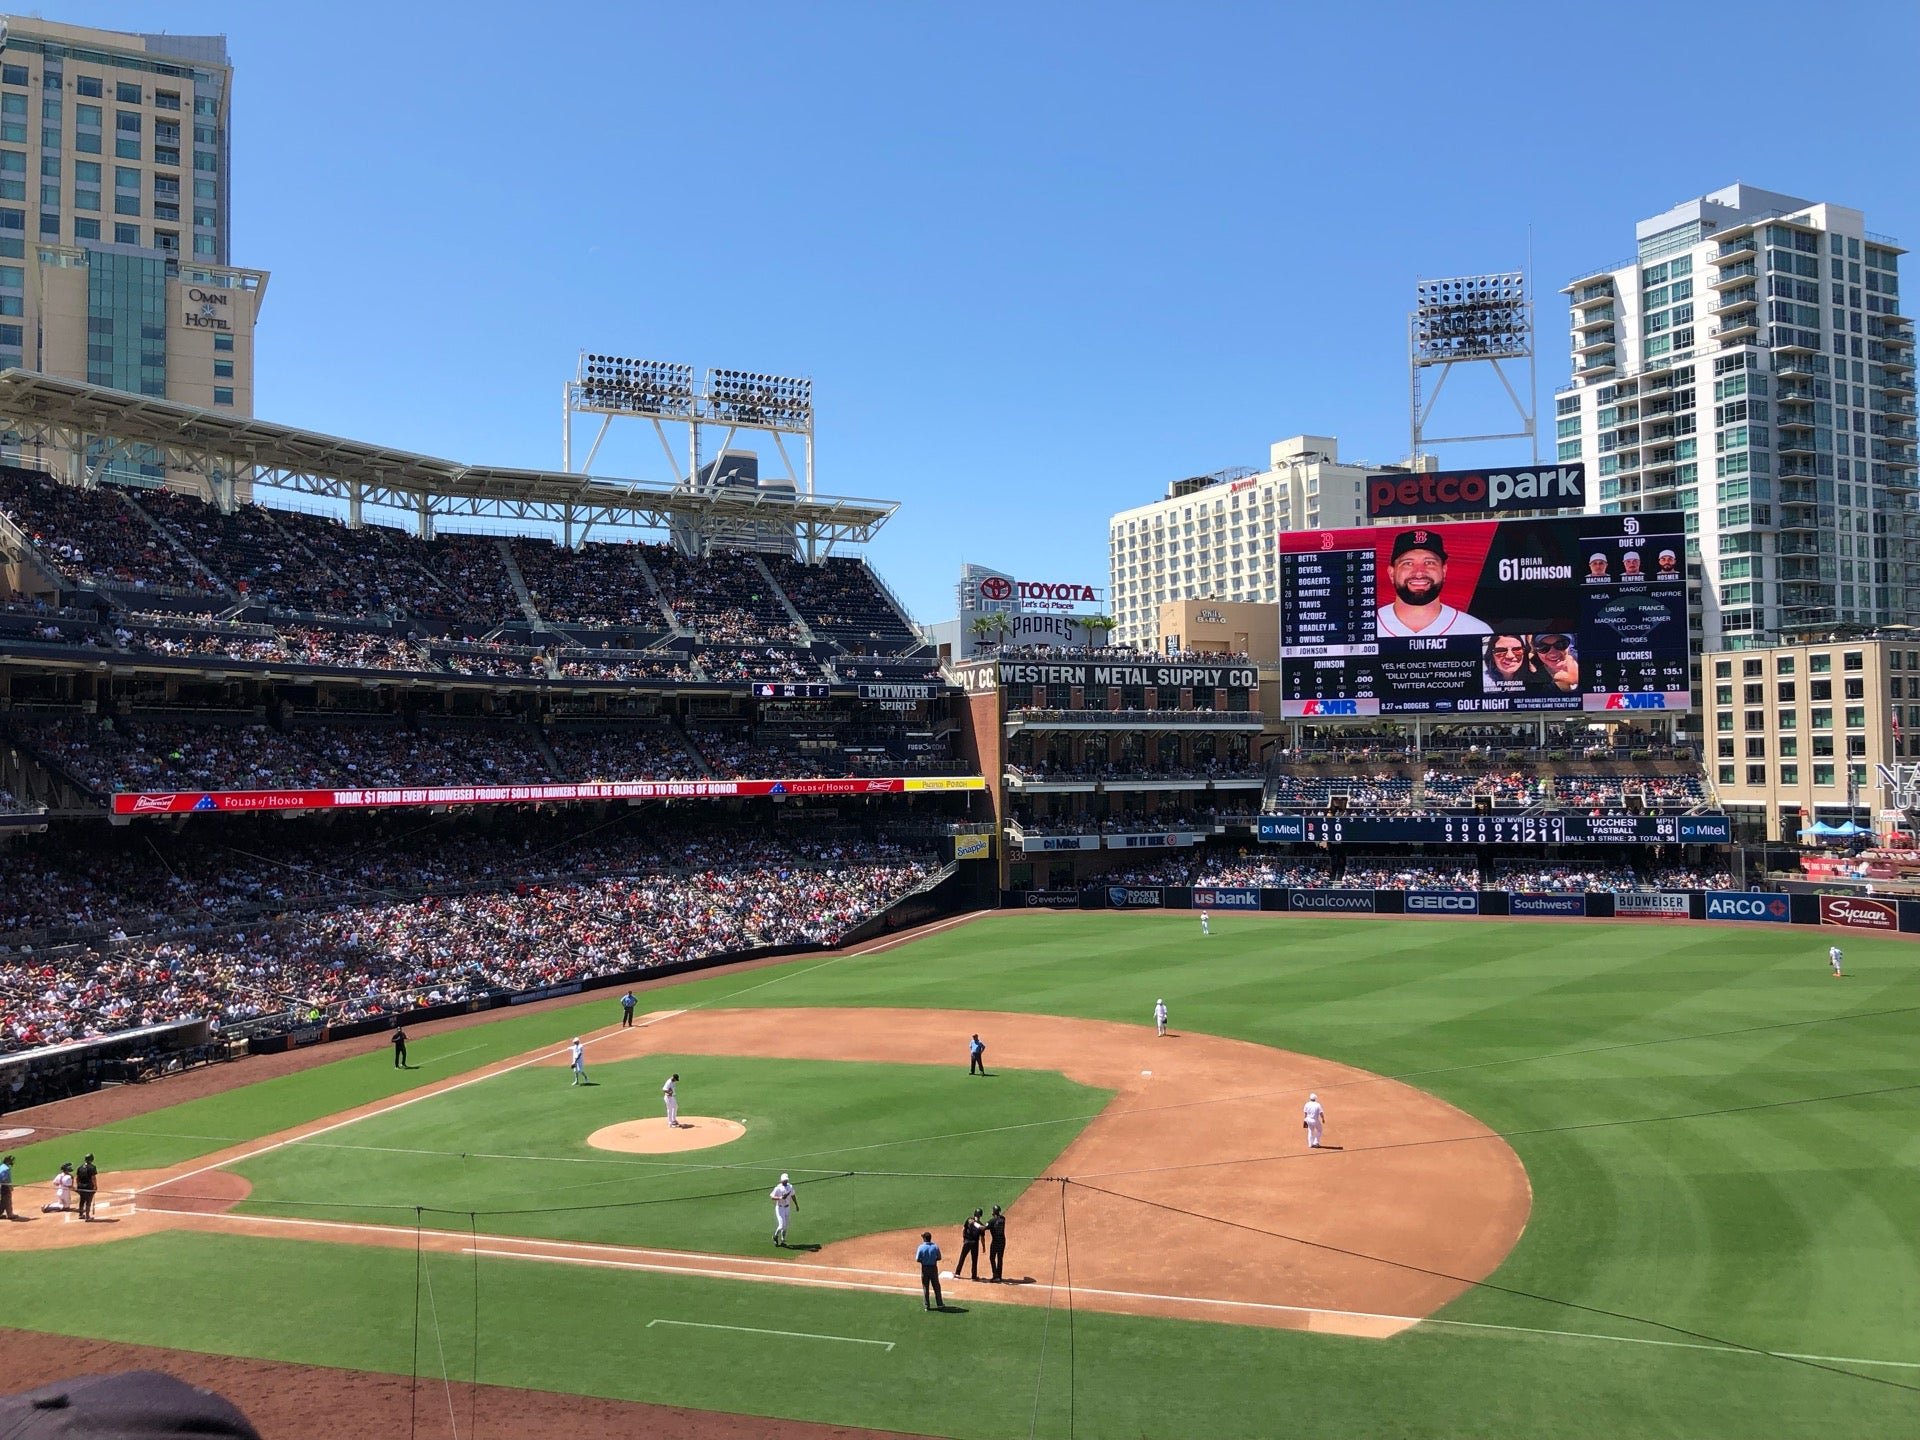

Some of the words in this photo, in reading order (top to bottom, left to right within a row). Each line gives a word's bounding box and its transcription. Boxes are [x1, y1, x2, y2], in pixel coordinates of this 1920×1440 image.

[189, 289, 227, 305] OMNI
[185, 313, 231, 329] HOTEL
[1372, 474, 1486, 513] petco
[1489, 468, 1581, 507] park
[1619, 539, 1633, 548] DUE
[1636, 538, 1646, 546] UP
[1360, 552, 1374, 560] .286
[1521, 557, 1542, 565] BRIAN
[1298, 566, 1322, 574] DEVERS
[1499, 559, 1519, 581] 61
[1521, 566, 1572, 580] JOHNSON
[1298, 577, 1330, 585] BOGAERTS
[1360, 575, 1375, 583] .307
[1017, 582, 1096, 601] TOYOTA
[1299, 589, 1330, 597] MARTINEZ
[1361, 587, 1375, 595] .312
[1051, 601, 1074, 610] Places
[1299, 601, 1321, 609] TRAVIS
[1012, 616, 1074, 641] PADRES
[1299, 624, 1326, 632] BRADLEY
[1361, 622, 1375, 630] .223
[1409, 640, 1425, 650] FUN
[1426, 638, 1448, 650] FACT
[1299, 647, 1327, 655] JOHNSON
[1617, 651, 1652, 660] LUCCHESI
[1314, 660, 1345, 669] JOHNSON
[1382, 662, 1395, 670] YES,
[1428, 661, 1460, 669] TWEETED
[1461, 660, 1476, 668] OUT
[979, 668, 996, 688] CO.
[1000, 665, 1086, 684] WESTERN
[1095, 667, 1152, 685] METAL
[1158, 668, 1222, 686] SUPPLY
[1229, 670, 1257, 687] CO.
[1435, 671, 1457, 679] FROM
[1392, 682, 1426, 690] TWITTER
[1427, 681, 1464, 689] ACCOUNT
[868, 686, 929, 698] CUTWATER
[880, 701, 917, 711] SPIRITS
[1457, 700, 1480, 711] GOLF
[1482, 698, 1510, 710] NIGHT
[792, 783, 816, 792] FOLDS
[818, 783, 824, 792] of
[827, 783, 854, 791] HONOR
[334, 792, 364, 805] TODAY,
[364, 791, 376, 804] $1
[377, 791, 400, 803] FROM
[402, 790, 427, 802] EVERY
[429, 789, 474, 802] BUDWEISER
[476, 788, 510, 800] PRODUCT
[511, 788, 529, 799] SOLD
[530, 787, 542, 798] VIA
[578, 785, 599, 797] WILL
[601, 785, 612, 796] BE
[614, 784, 654, 796] DONATED
[655, 784, 666, 795] TO
[668, 784, 694, 795] FOLDS
[696, 784, 707, 794] OF
[708, 783, 737, 794] HONOR
[225, 797, 256, 807] FOLDS
[258, 796, 267, 806] of
[269, 796, 304, 805] HONOR
[1275, 824, 1300, 834] Mitel
[1526, 818, 1535, 828] B
[1539, 818, 1547, 828] S
[1551, 818, 1561, 828] O
[1697, 825, 1725, 835] Mitel
[1657, 825, 1672, 834] 88
[1526, 829, 1536, 842] 2
[1539, 829, 1546, 842] 1
[1552, 829, 1560, 842] 1
[957, 840, 987, 858] Snapple
[1010, 850, 1027, 861] 336
[1128, 890, 1160, 898] ROCKET
[1128, 897, 1160, 905] LEAGUE
[1292, 893, 1372, 908] Qualcomm
[1407, 896, 1476, 909] GEICO
[1514, 899, 1572, 910] Southwest
[1620, 896, 1683, 907] BUDWEISER
[1708, 899, 1766, 915] ARCO
[1829, 900, 1888, 924] Sycuan
